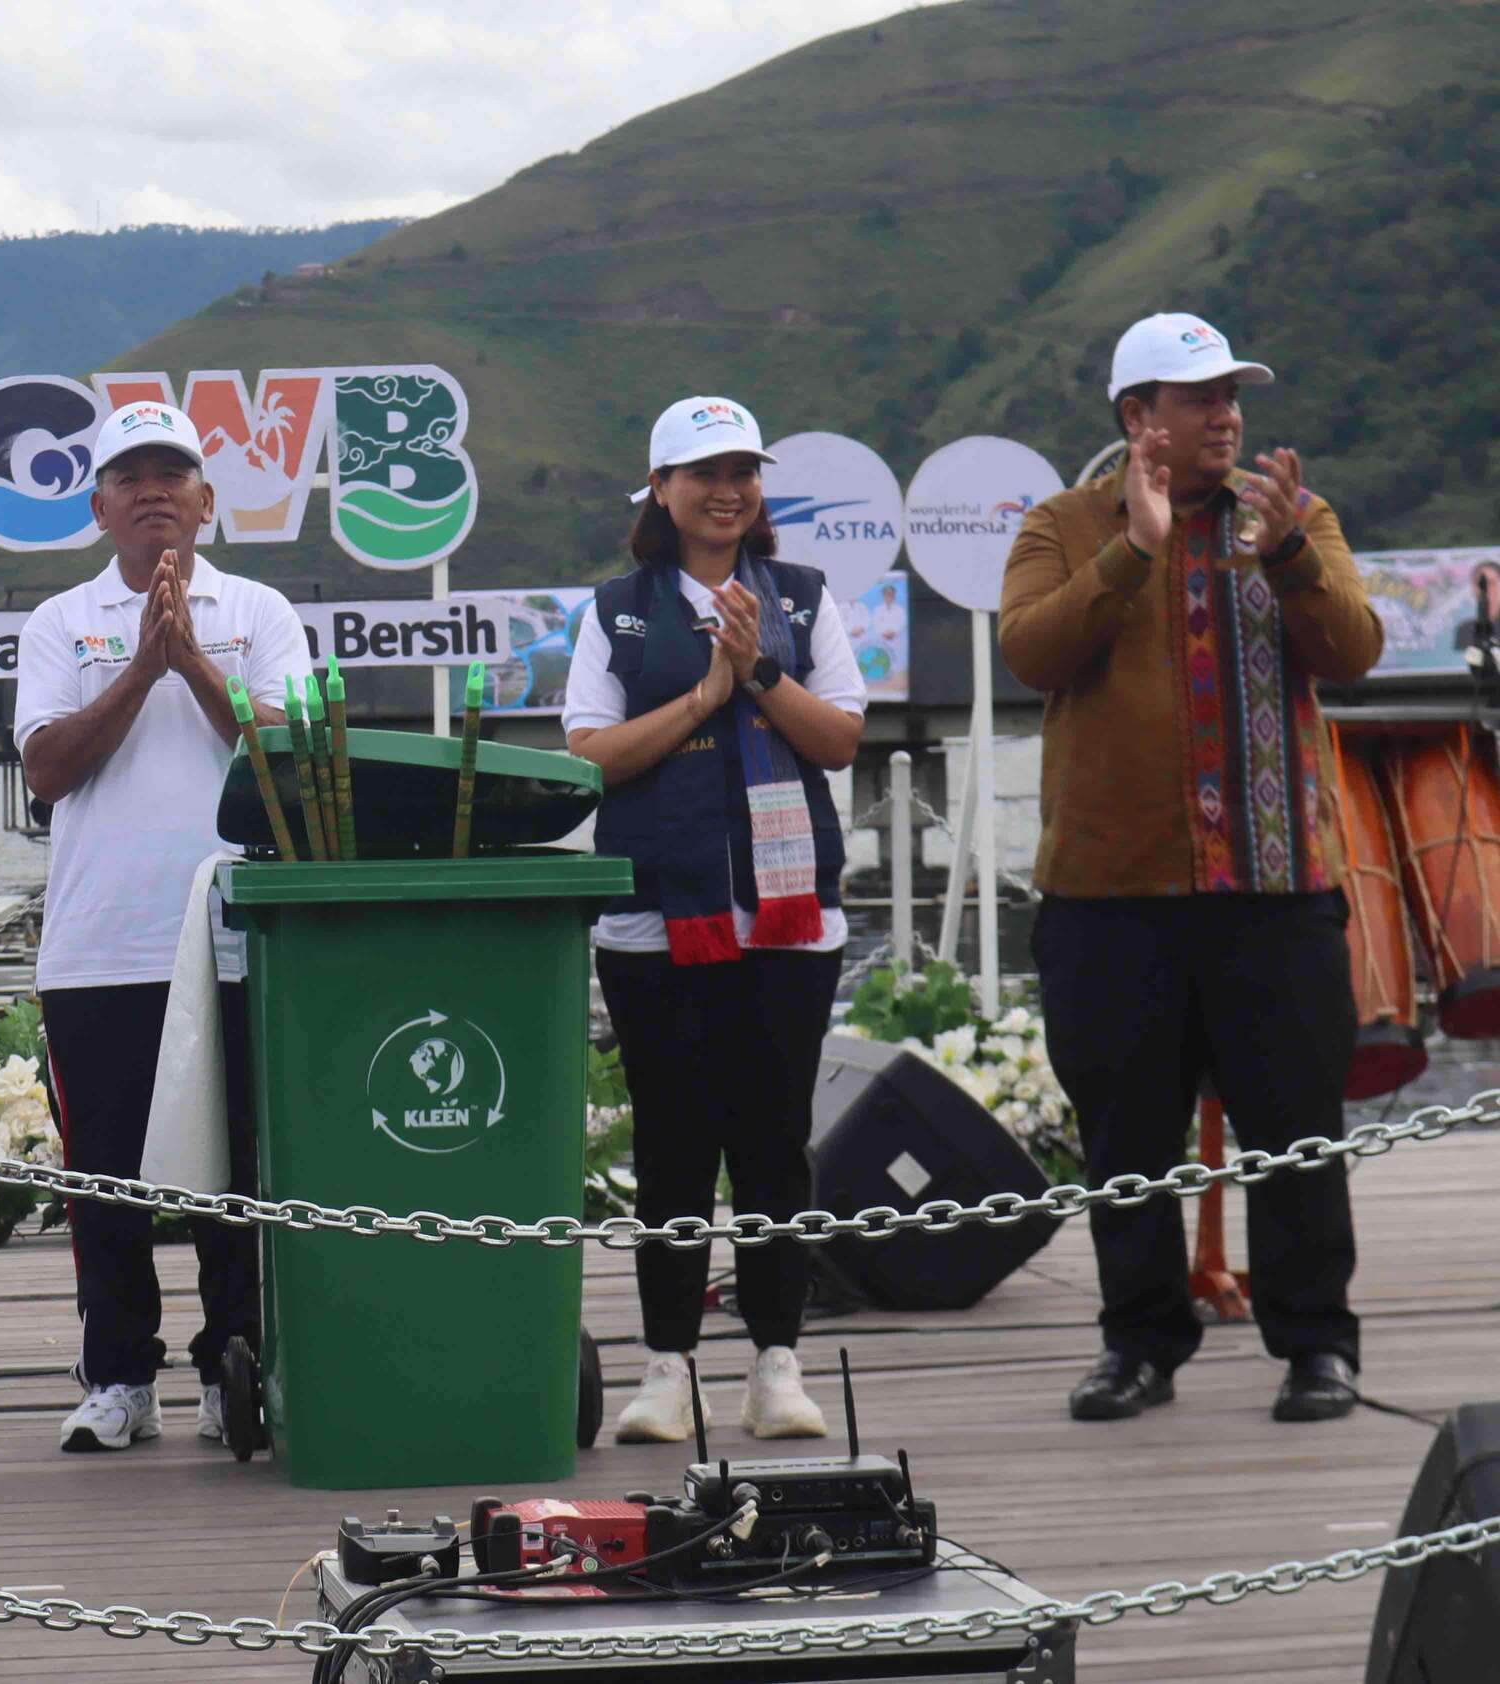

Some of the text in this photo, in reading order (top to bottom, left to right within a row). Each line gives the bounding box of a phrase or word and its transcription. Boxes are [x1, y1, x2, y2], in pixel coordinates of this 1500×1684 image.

[908, 503, 982, 517] wonderful
[815, 521, 896, 540] ASTRA
[332, 604, 498, 660] Bersih
